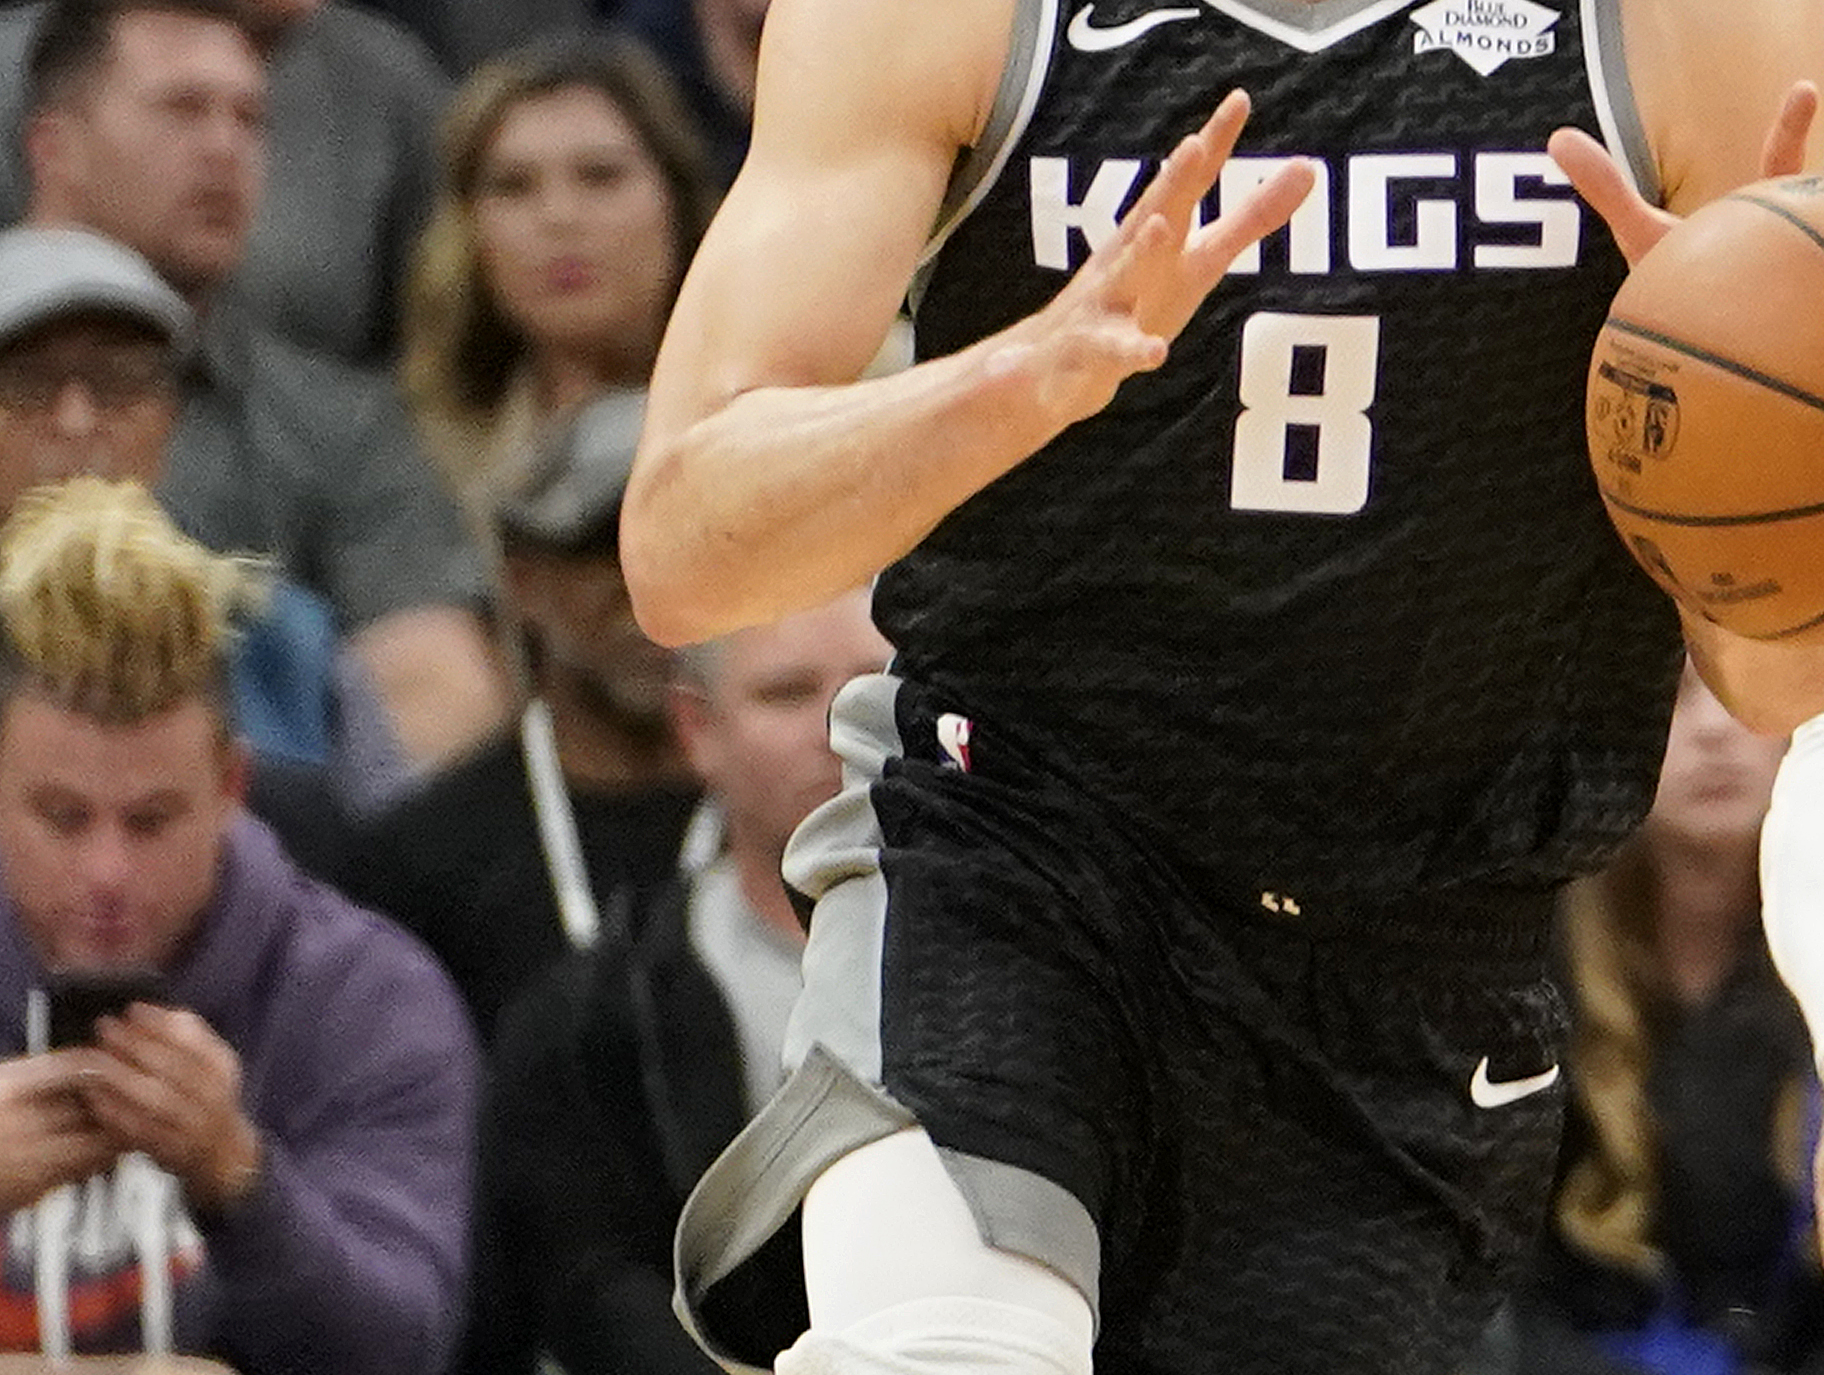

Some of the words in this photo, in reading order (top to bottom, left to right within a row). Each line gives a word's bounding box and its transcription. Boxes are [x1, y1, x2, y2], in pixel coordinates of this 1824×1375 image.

[1420, 29, 1549, 55] ALMONDS
[1029, 152, 1580, 274] KNGS
[1229, 311, 1381, 515] 8
